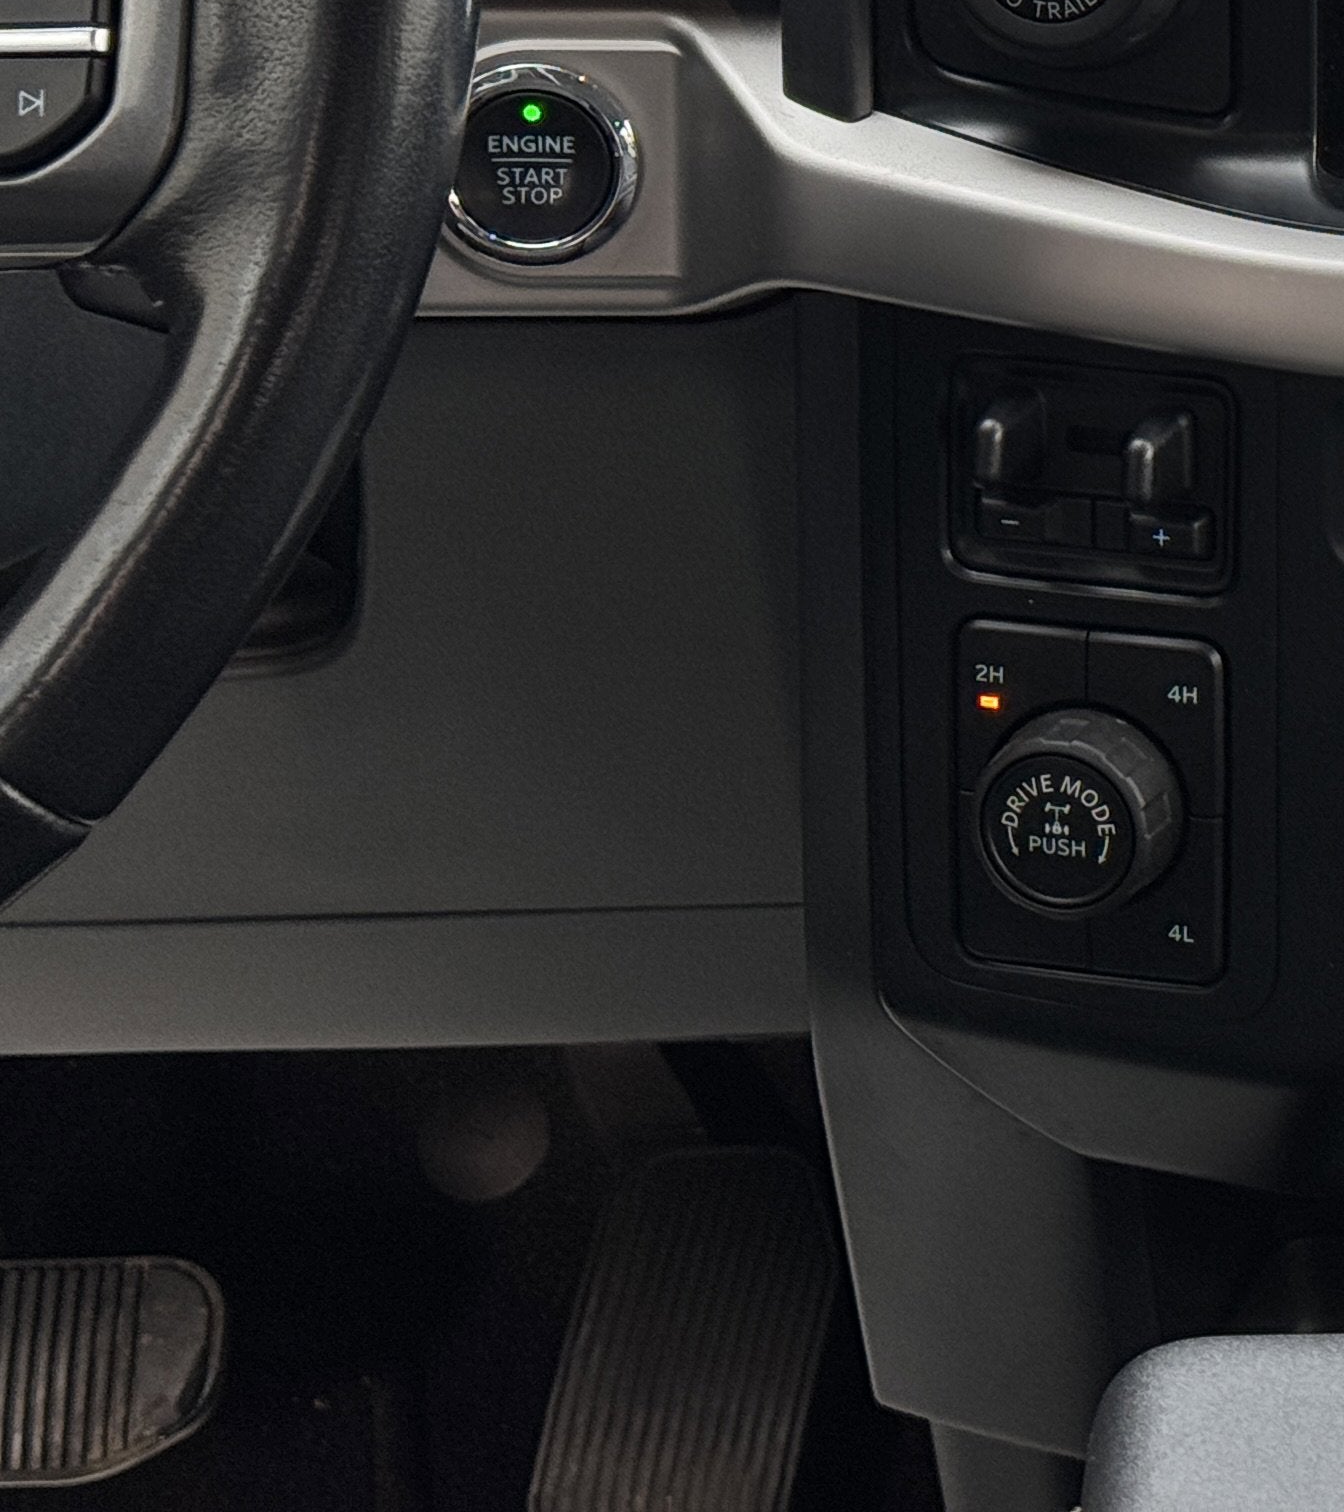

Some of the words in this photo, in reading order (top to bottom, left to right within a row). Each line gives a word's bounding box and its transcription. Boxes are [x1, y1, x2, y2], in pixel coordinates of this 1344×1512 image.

[488, 135, 575, 154] ENGINE
[497, 167, 568, 186] START
[503, 187, 563, 205] STOP
[975, 664, 1004, 684] 2H
[1167, 685, 1198, 705] 4H
[1002, 773, 1054, 828] DRIVE
[1060, 775, 1116, 837] MODE
[1028, 835, 1087, 859] PUSH
[1168, 924, 1195, 943] 4L
